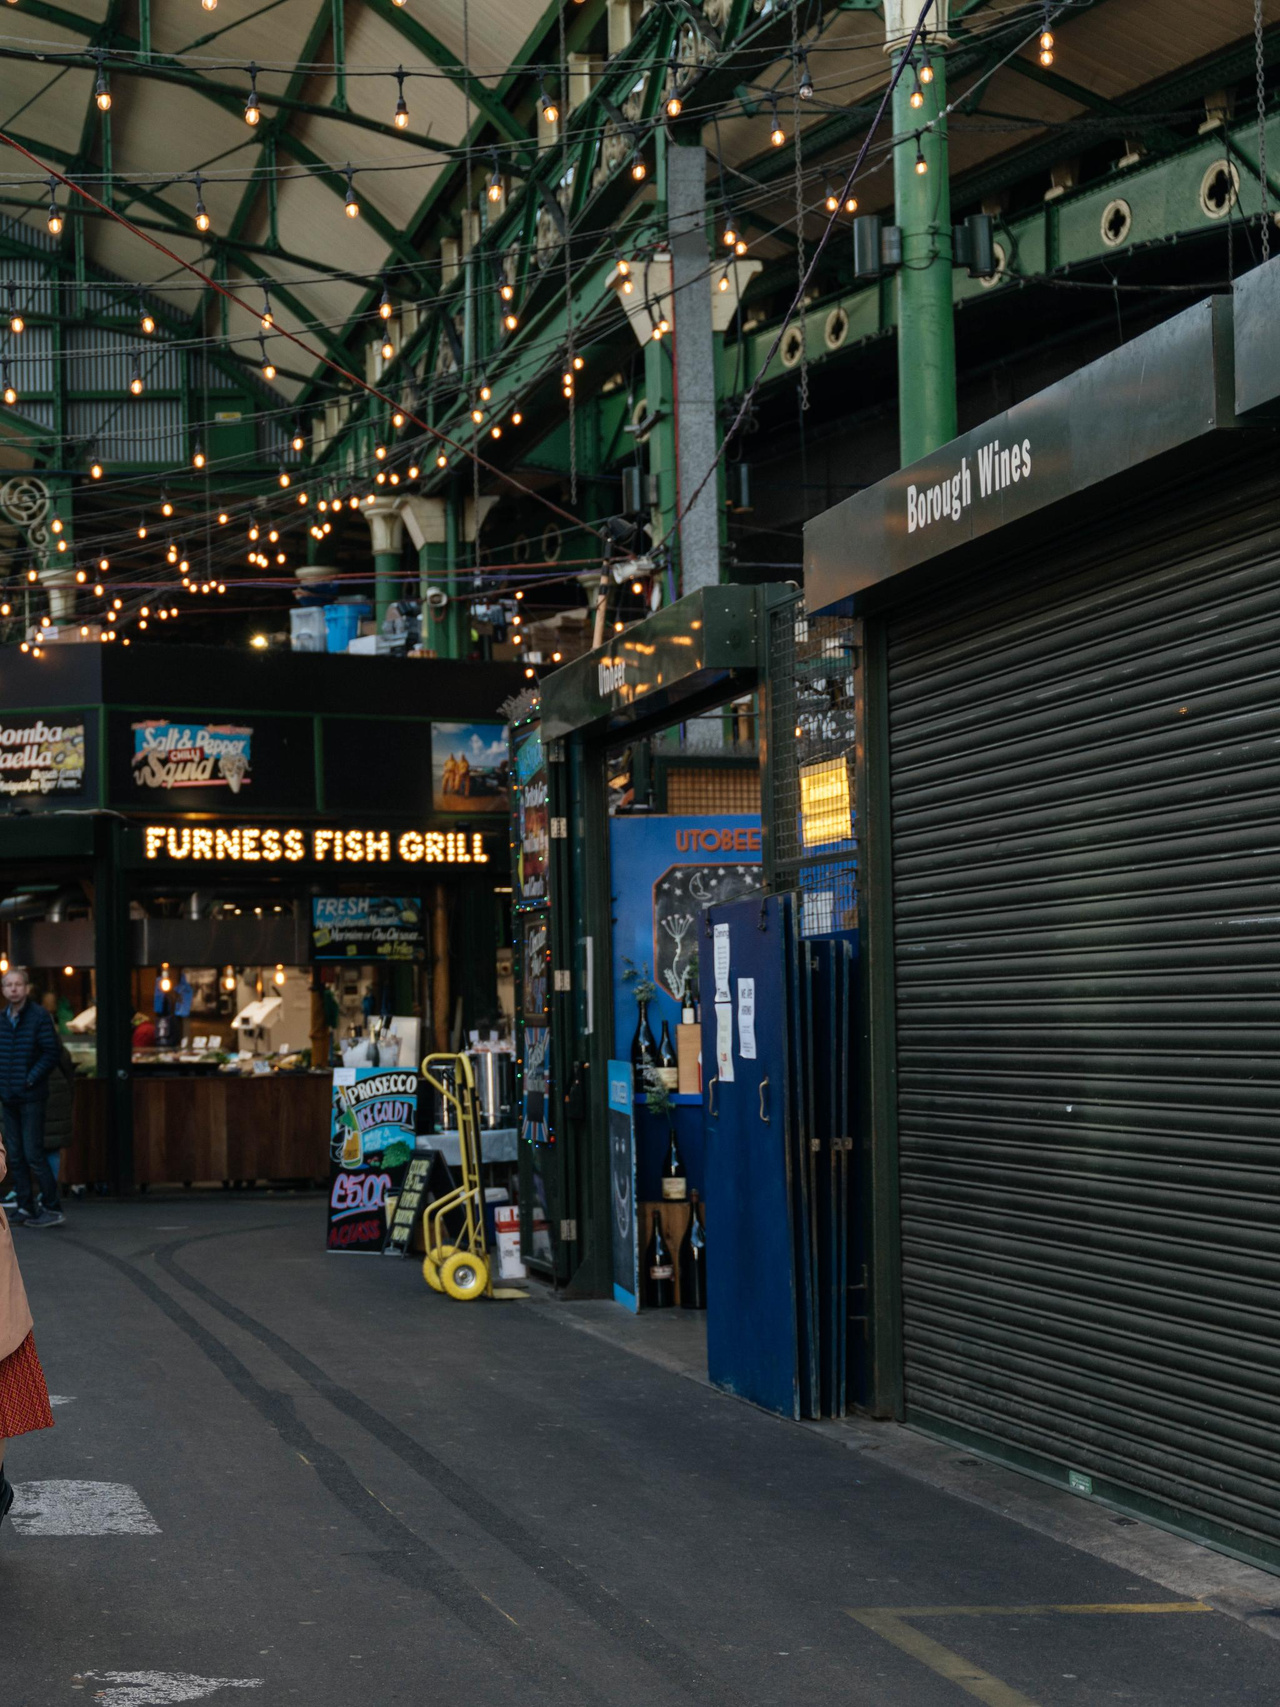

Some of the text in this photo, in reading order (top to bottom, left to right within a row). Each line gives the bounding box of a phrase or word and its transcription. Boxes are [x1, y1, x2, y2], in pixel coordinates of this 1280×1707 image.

[907, 438, 1031, 533] Borough Wines
[598, 659, 625, 697] Utobeer
[143, 727, 246, 755] Salt & Pepper
[133, 749, 214, 788] Squid
[146, 827, 304, 861] FURNESS
[314, 830, 391, 861] FISH
[399, 831, 490, 863] GRILL
[676, 829, 762, 852] UTOBEE
[317, 897, 370, 915] FRESH
[348, 1074, 417, 1105] PROSECCO
[356, 1105, 377, 1131] ICE
[331, 1173, 391, 1209] £5.00
